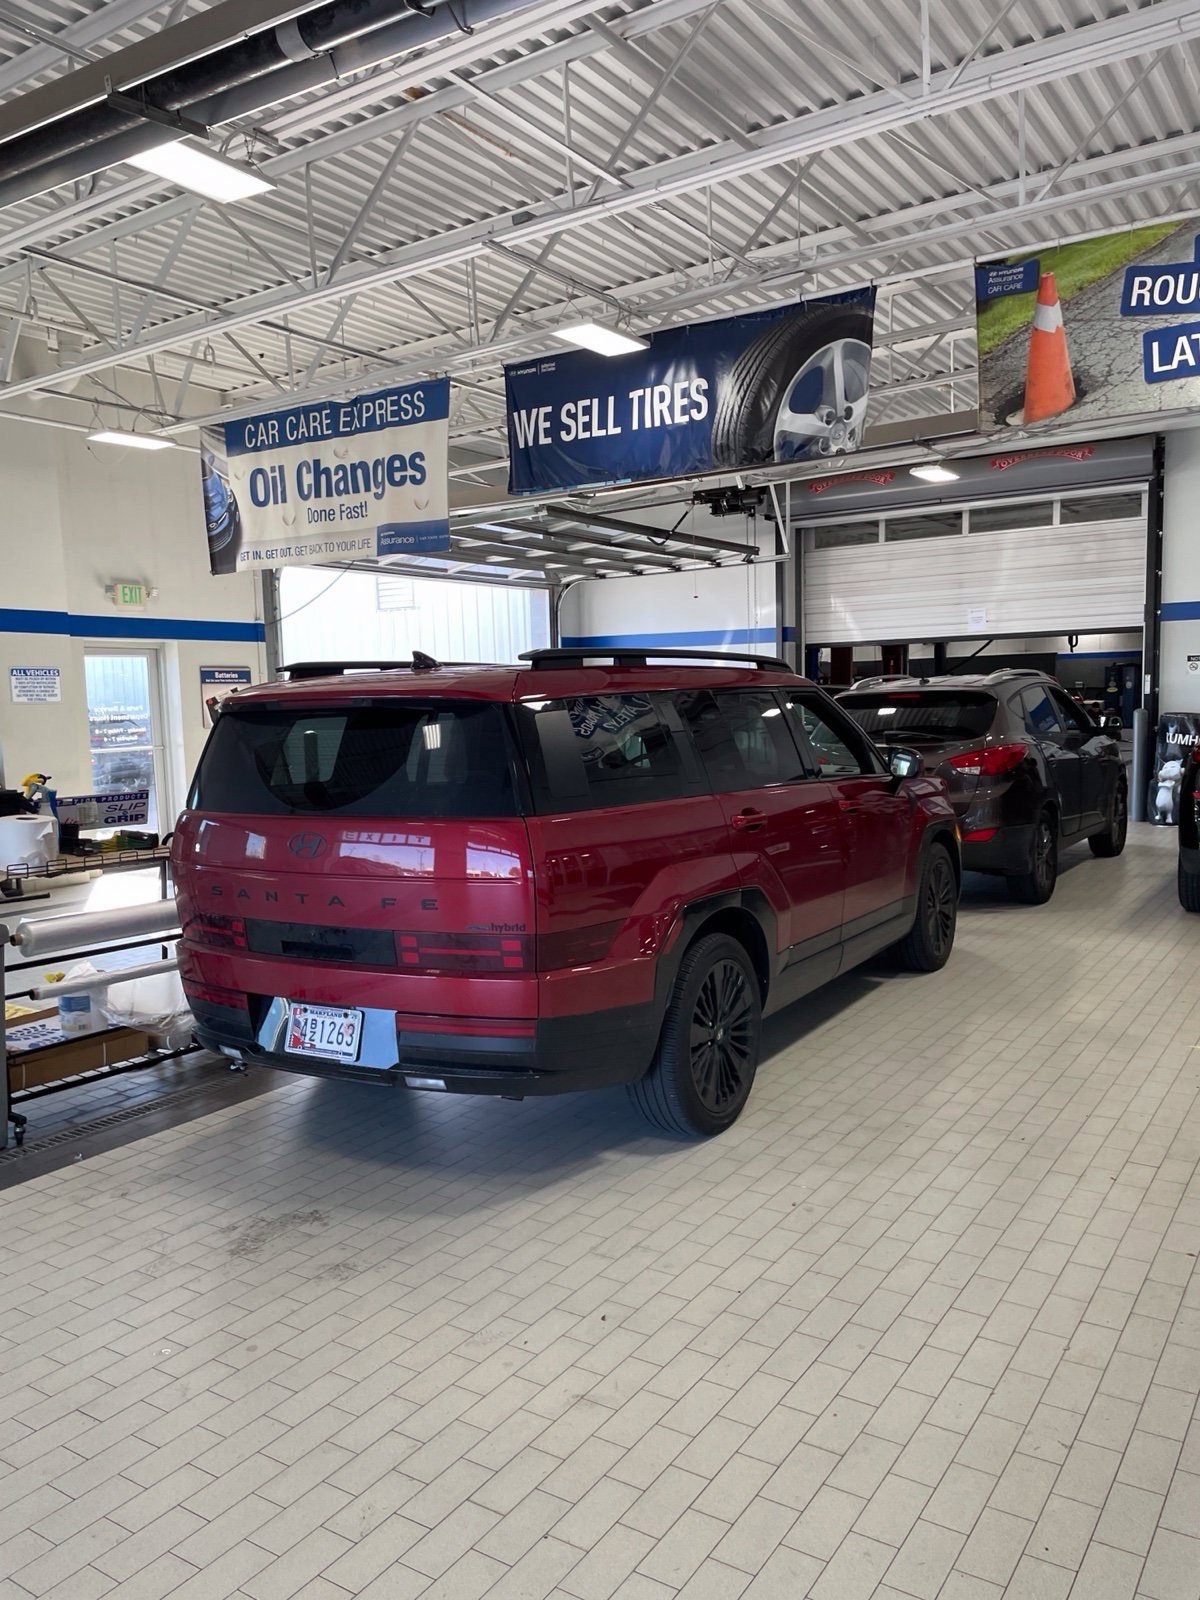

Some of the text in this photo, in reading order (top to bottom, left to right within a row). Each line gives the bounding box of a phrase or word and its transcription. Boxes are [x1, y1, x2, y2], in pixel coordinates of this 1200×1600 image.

[987, 273, 1024, 284] Assurance
[987, 281, 1023, 295] CAR CARE
[1130, 273, 1200, 306] ROU
[245, 390, 425, 448] CAR CARE EXPRESS
[513, 378, 709, 449] WE SELL TIRES
[249, 451, 427, 508] Oil Changes
[307, 501, 368, 524] Done Fast!
[380, 536, 415, 545] Assurance
[240, 550, 250, 562] GET
[252, 549, 264, 560] IN.
[265, 548, 278, 560] GET
[279, 546, 293, 558] OUT.
[295, 545, 308, 557] GET
[309, 543, 325, 556] BACK
[325, 541, 335, 552] TO
[336, 539, 356, 552] YOUR
[122, 585, 142, 604] EXIT
[101, 793, 147, 803] PRODUCTS
[105, 802, 146, 813] SLIP
[103, 814, 145, 825] GRIP
[211, 885, 438, 911] SANTA FE
[491, 922, 526, 934] hybrid
[310, 1009, 342, 1018] MARYLAND
